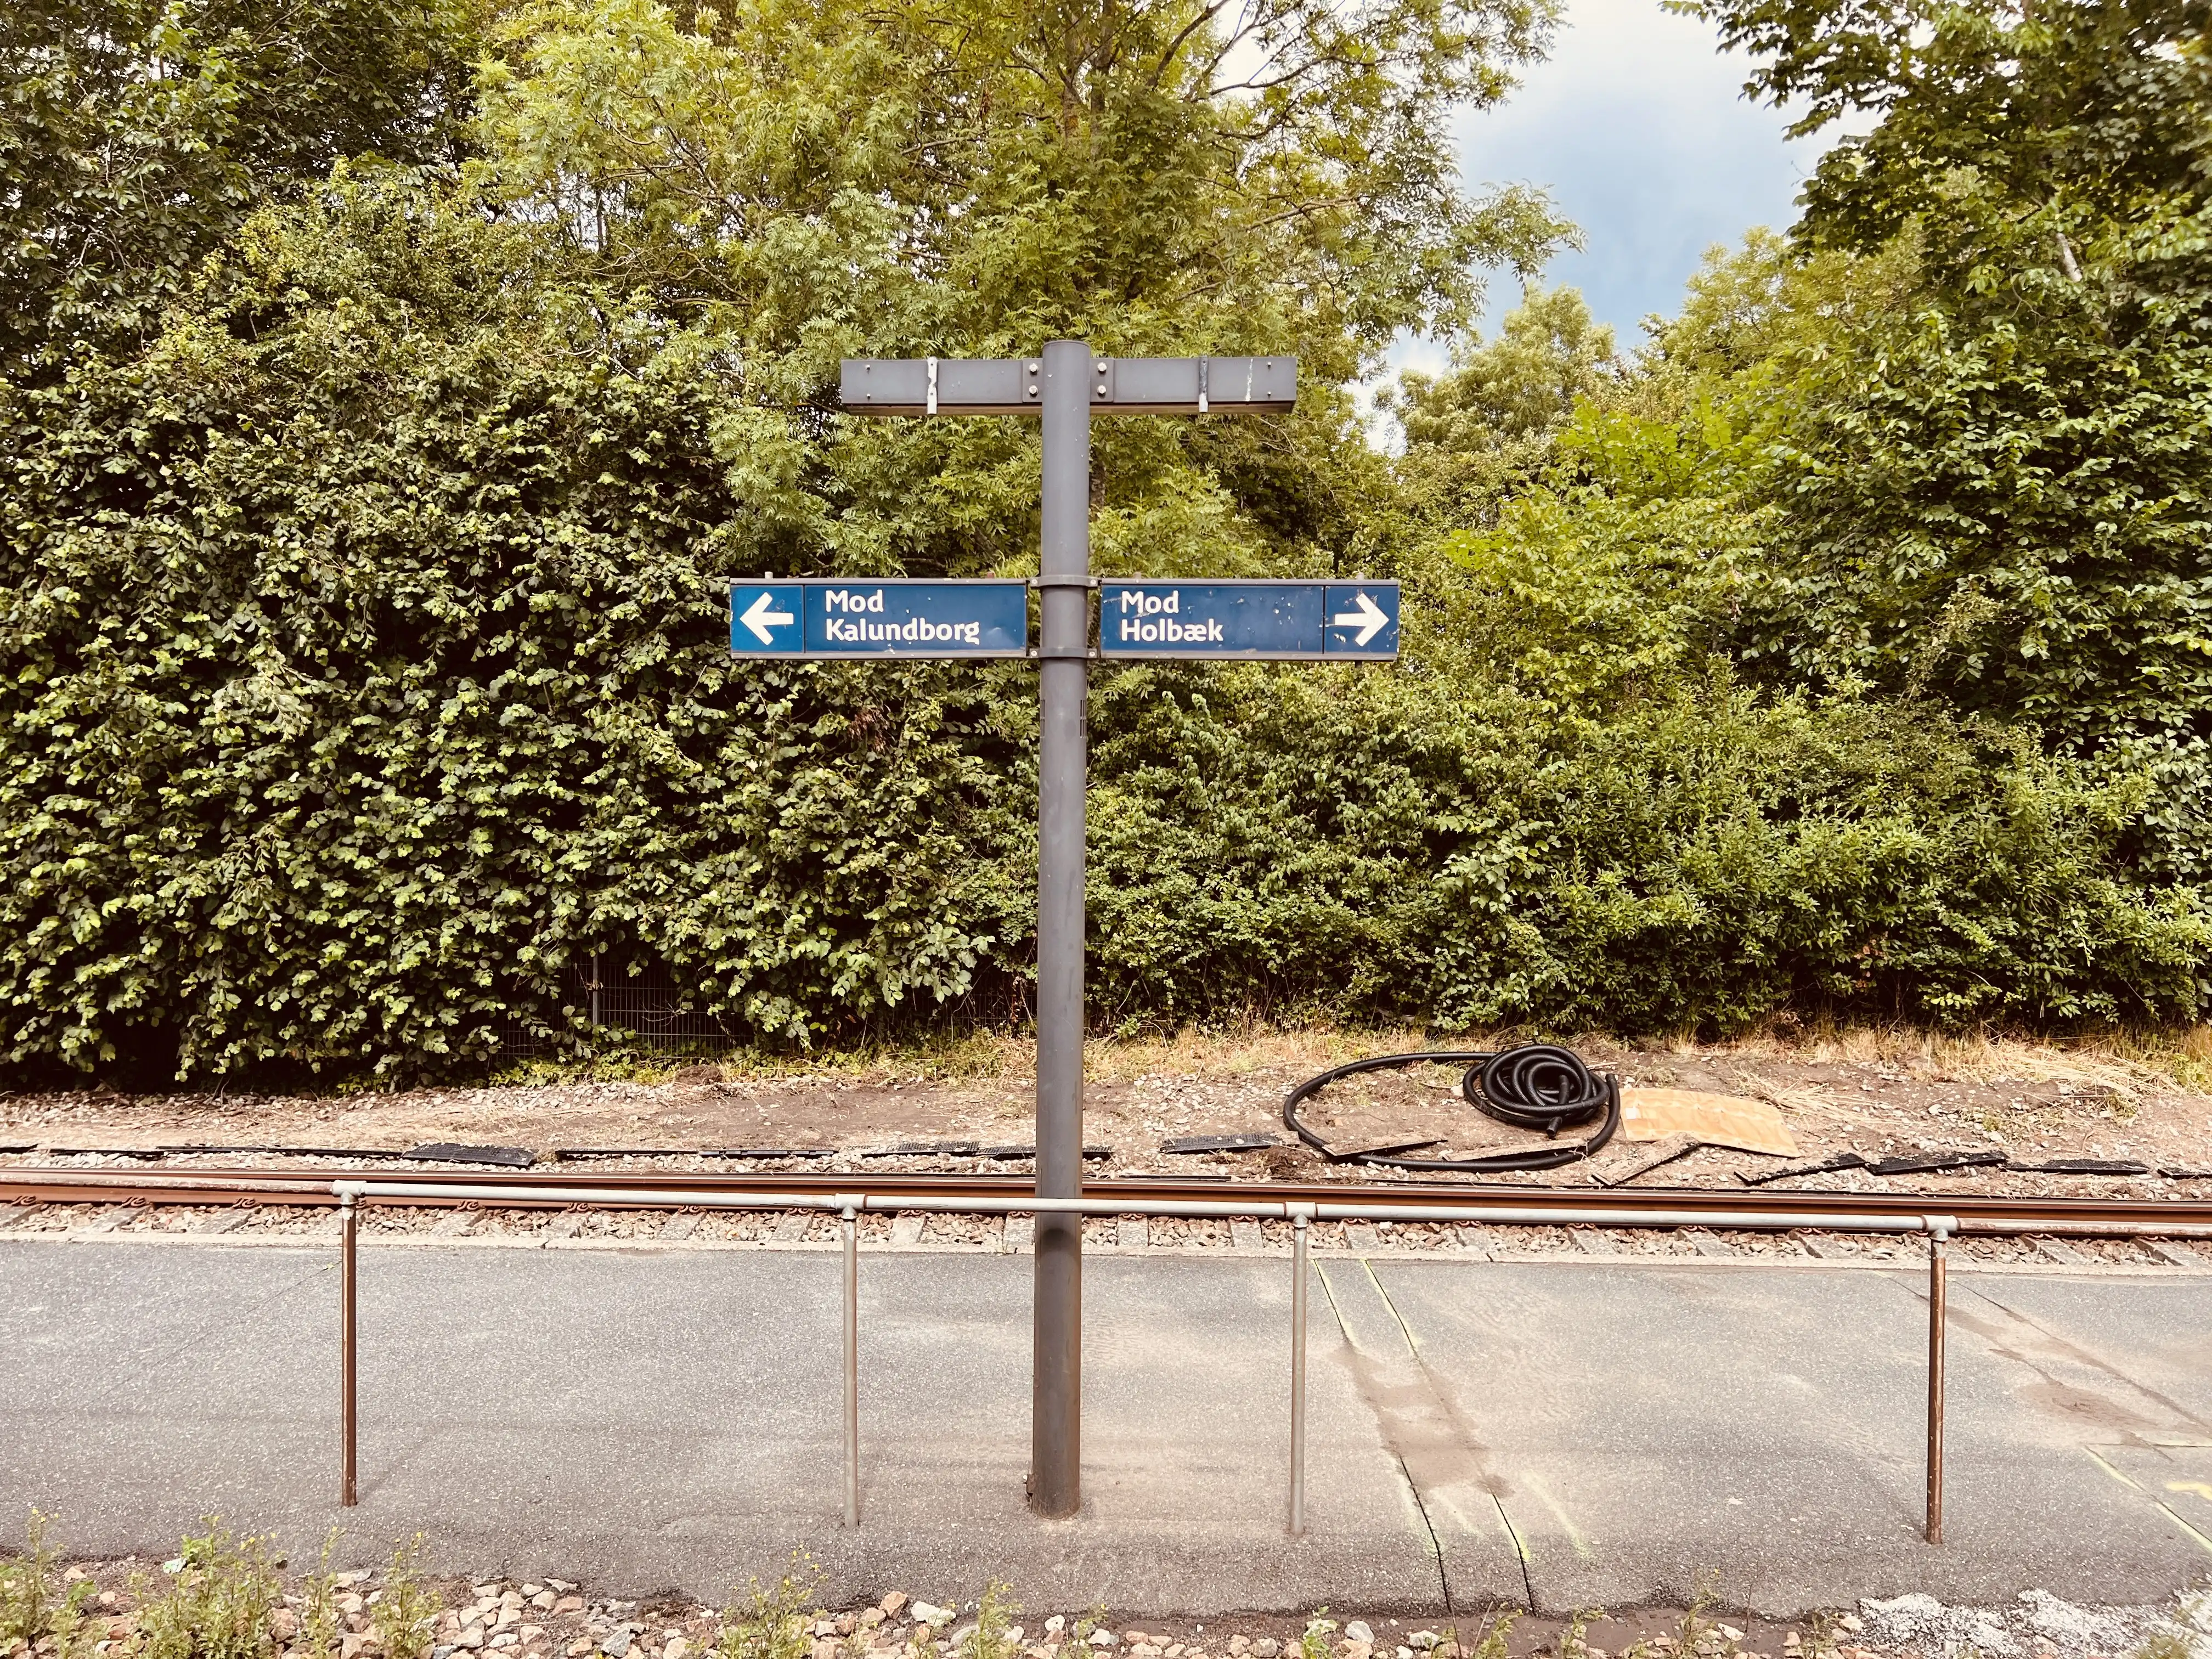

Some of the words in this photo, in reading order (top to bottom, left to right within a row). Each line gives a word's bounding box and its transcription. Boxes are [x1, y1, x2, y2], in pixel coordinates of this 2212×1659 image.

[826, 589, 884, 613] Mod
[1121, 590, 1179, 614] Mod
[826, 618, 980, 645] Kalundborg
[1121, 618, 1224, 641] Holbæk
